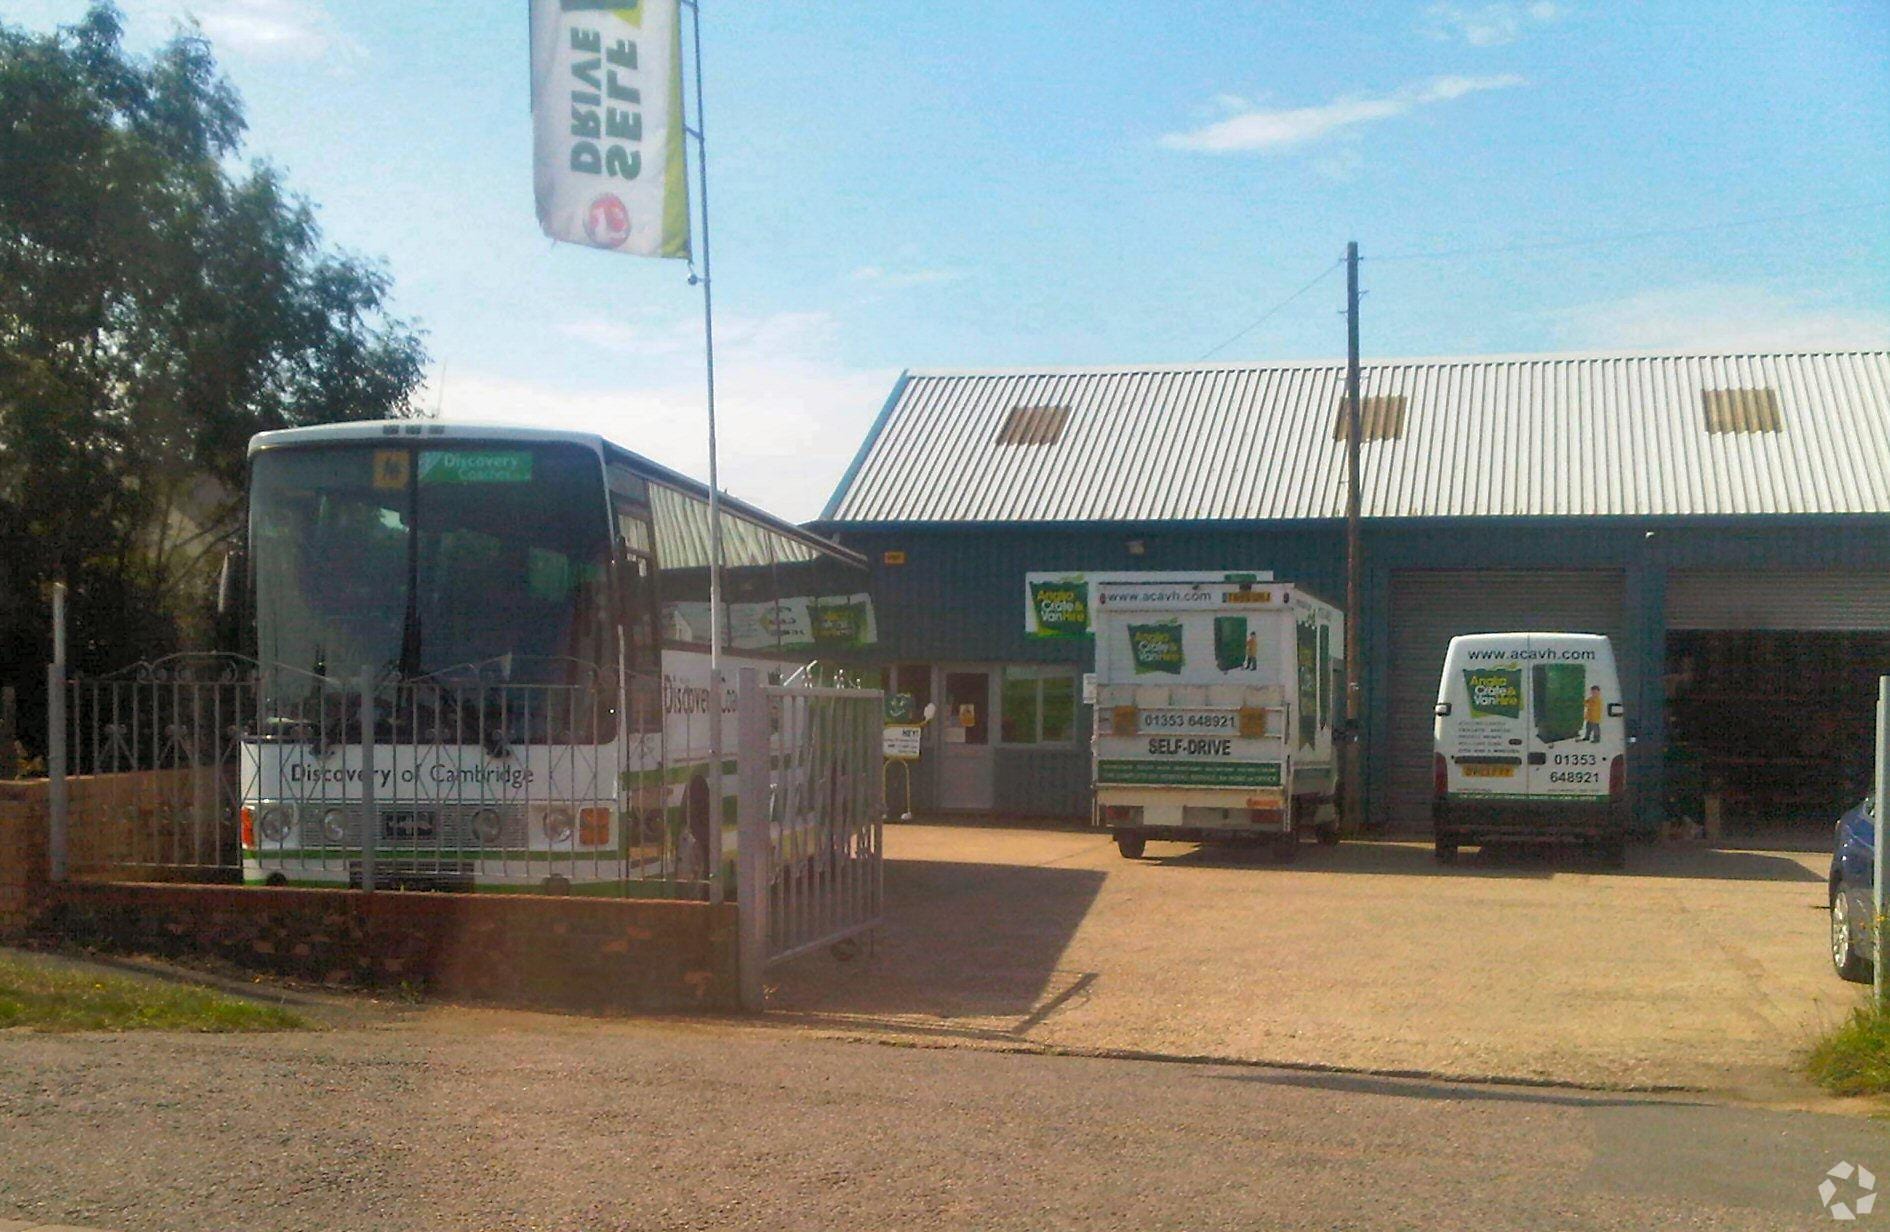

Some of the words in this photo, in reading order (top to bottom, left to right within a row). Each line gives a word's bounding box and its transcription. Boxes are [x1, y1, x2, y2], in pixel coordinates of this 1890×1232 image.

[444, 453, 518, 470] Discovery
[1107, 590, 1213, 602] www.acavh.com
[1467, 648, 1597, 660] www.acavh.com
[1145, 714, 1184, 727] 01353
[1188, 715, 1236, 728] 648921
[1148, 738, 1231, 756] SELF-DRIVE
[1554, 753, 1597, 766] 01353
[291, 763, 391, 788] Discovery
[401, 763, 421, 783] of
[429, 763, 534, 789] Cambridge
[1550, 771, 1600, 783] 648921
